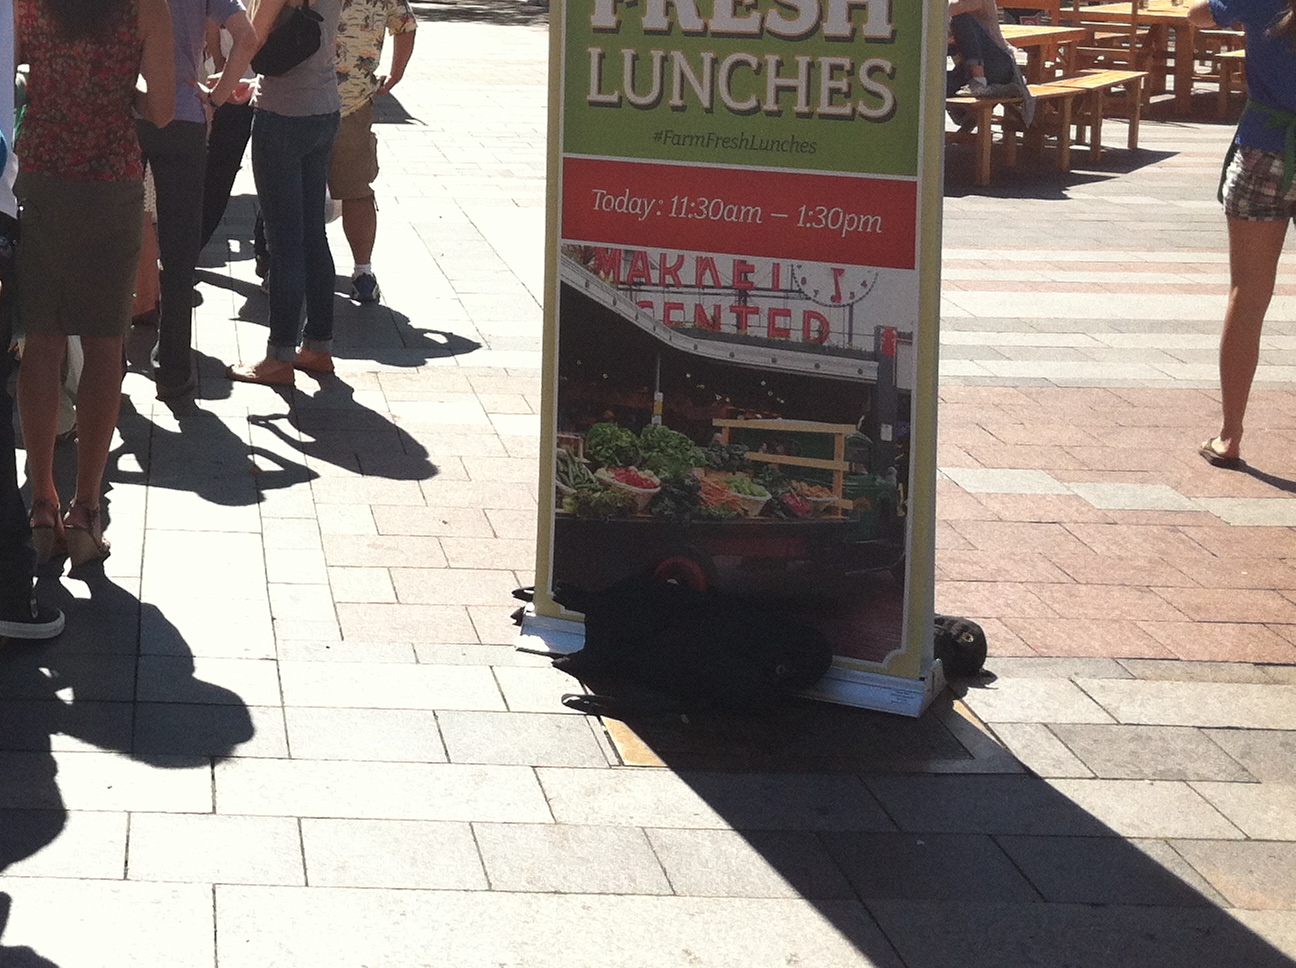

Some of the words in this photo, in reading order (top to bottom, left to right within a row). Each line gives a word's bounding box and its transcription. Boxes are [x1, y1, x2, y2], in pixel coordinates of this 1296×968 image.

[586, 47, 898, 122] LUNCHES
[652, 130, 818, 155] #FarmFreshLunches
[591, 187, 664, 222] Today:
[669, 195, 763, 225] 11:30am
[797, 204, 883, 238] 1:30pm
